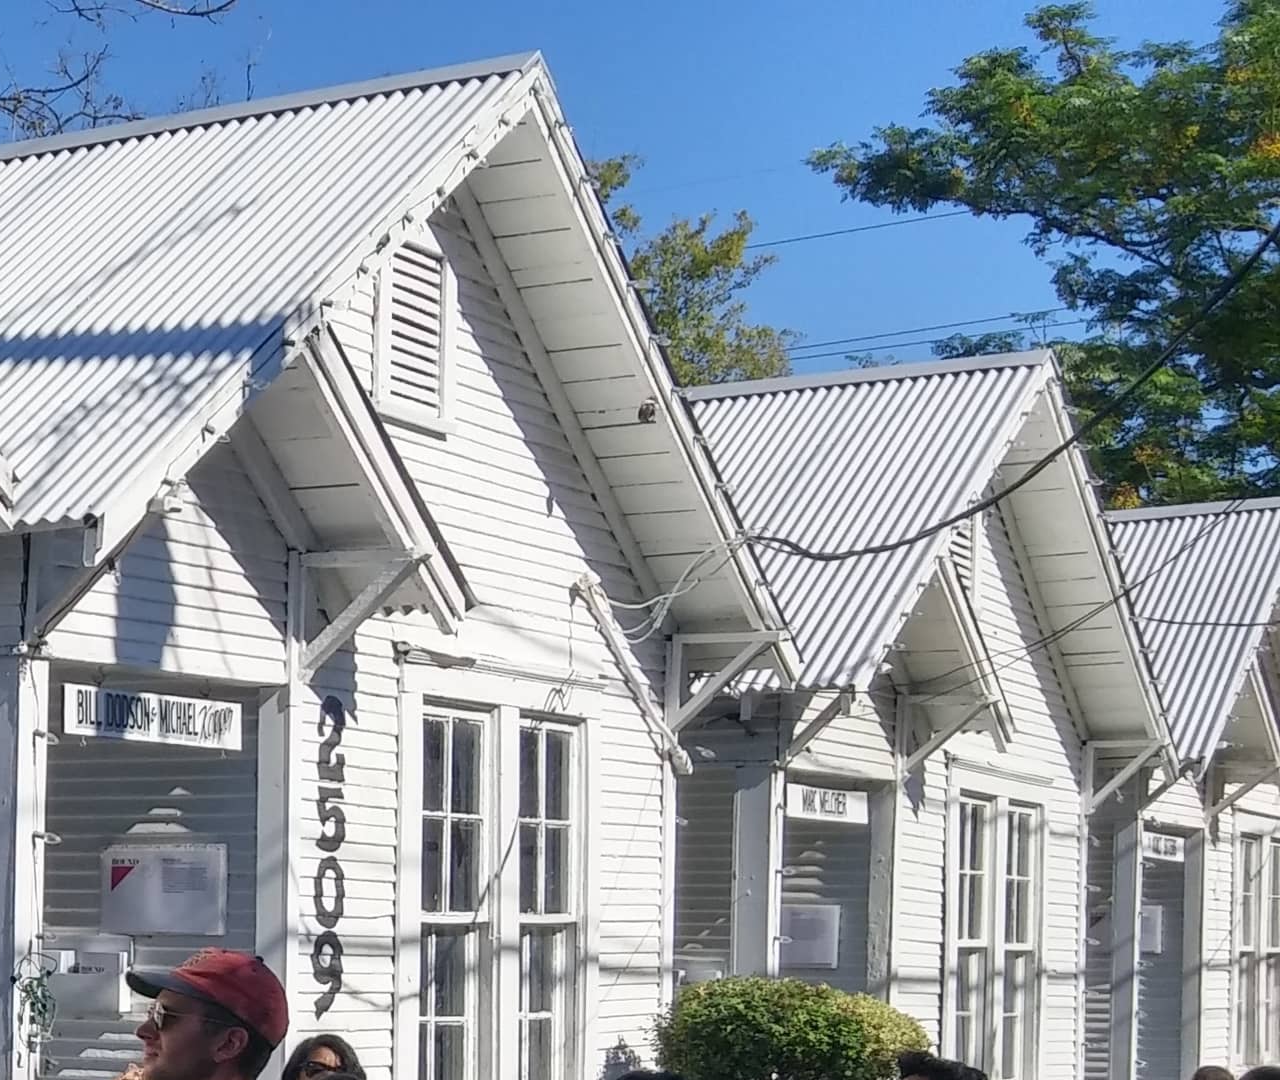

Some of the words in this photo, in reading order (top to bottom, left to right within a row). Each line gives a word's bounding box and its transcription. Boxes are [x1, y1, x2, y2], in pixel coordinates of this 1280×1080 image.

[77, 688, 103, 727] BILL
[105, 692, 151, 732] DODSON
[158, 698, 199, 737] MICHAEL
[310, 695, 347, 1021] 2509
